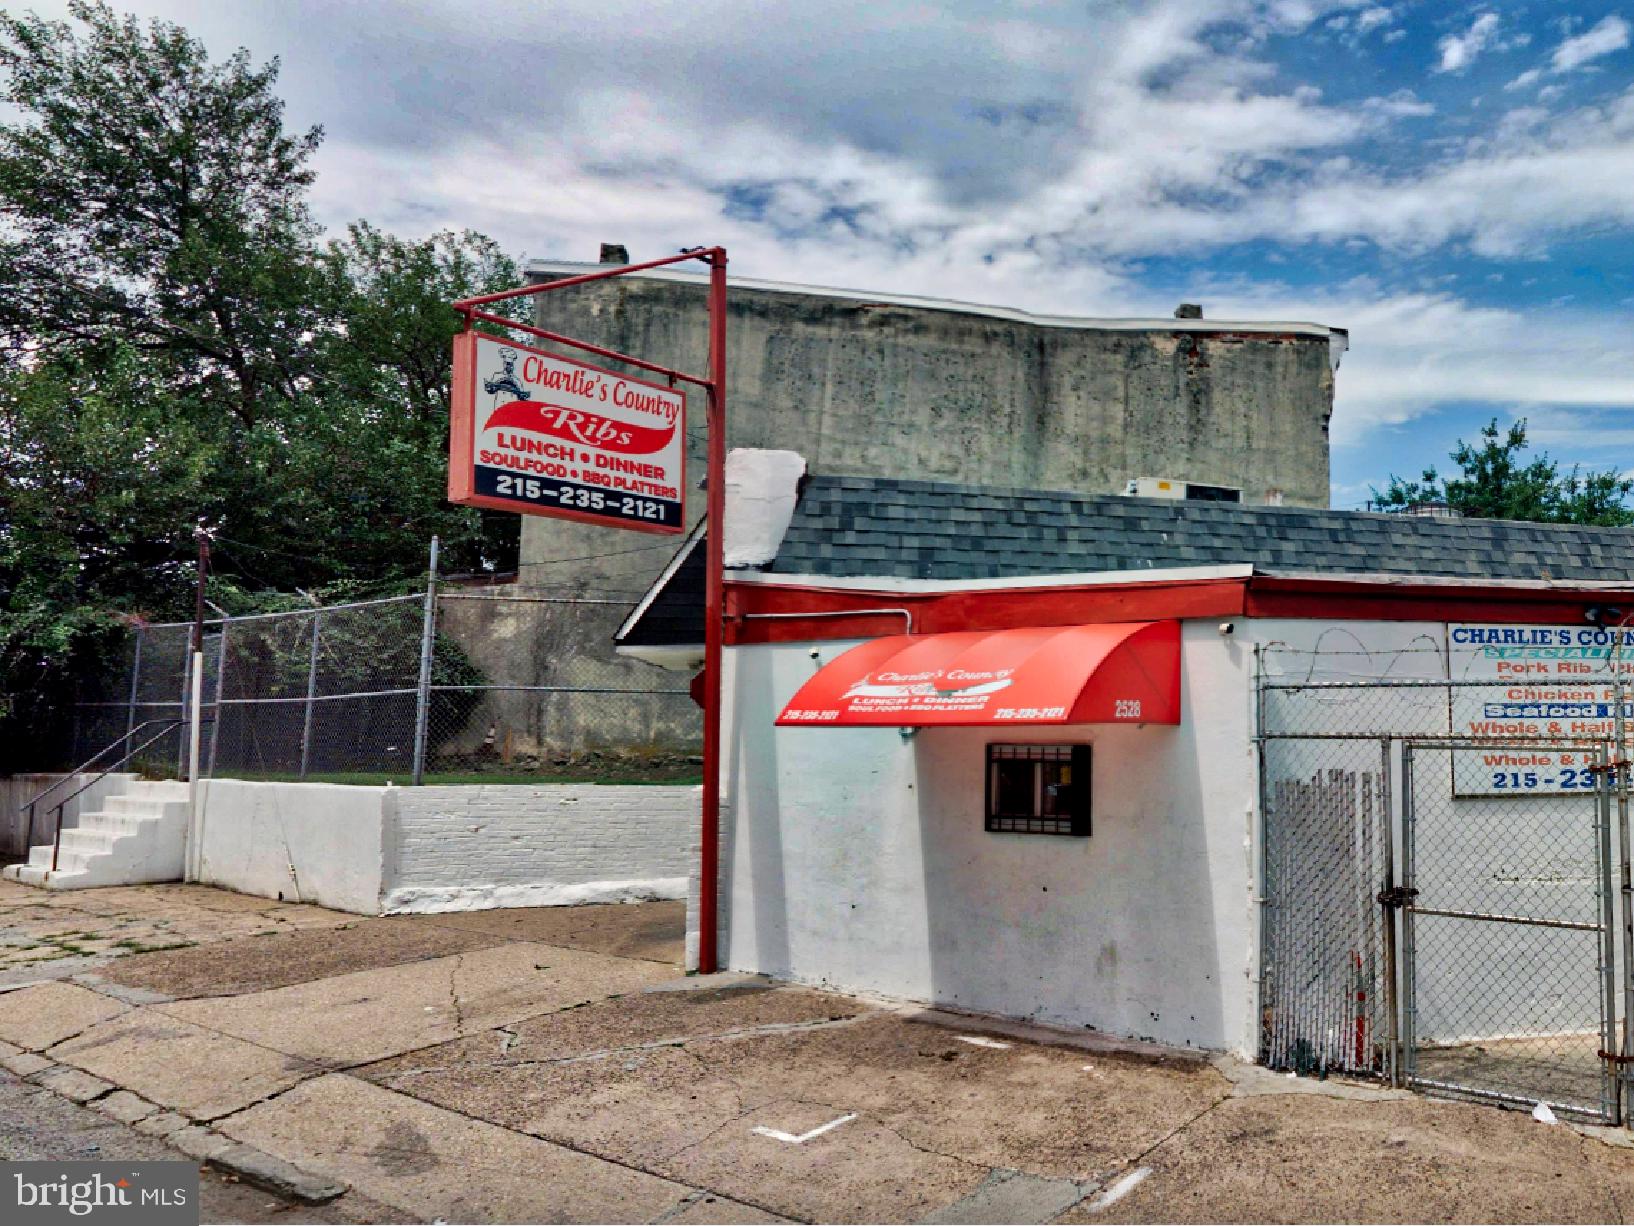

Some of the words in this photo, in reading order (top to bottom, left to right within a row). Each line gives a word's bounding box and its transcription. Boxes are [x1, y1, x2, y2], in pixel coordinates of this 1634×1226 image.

[523, 356, 608, 401] Charlie's
[613, 381, 680, 425] Country
[540, 406, 633, 446] Ribs
[497, 432, 575, 462] LUNCH
[595, 453, 665, 481] DINNER
[479, 449, 567, 478] SOULFOOD
[582, 470, 611, 486] BBQ
[613, 477, 678, 499] PLATTERS
[496, 475, 666, 521] 215-235-2121
[1453, 628, 1572, 646] CHARLIE'S
[1497, 662, 1549, 673] Pork
[1557, 662, 1592, 673] Rib
[1507, 689, 1596, 700] Chicken
[1115, 700, 1141, 717] 2528
[1485, 704, 1598, 717] Seafood
[1469, 721, 1539, 734] Whole
[1547, 721, 1562, 733] &
[1571, 721, 1614, 734] Half
[1483, 754, 1552, 767] Whole
[1560, 755, 1575, 765] &
